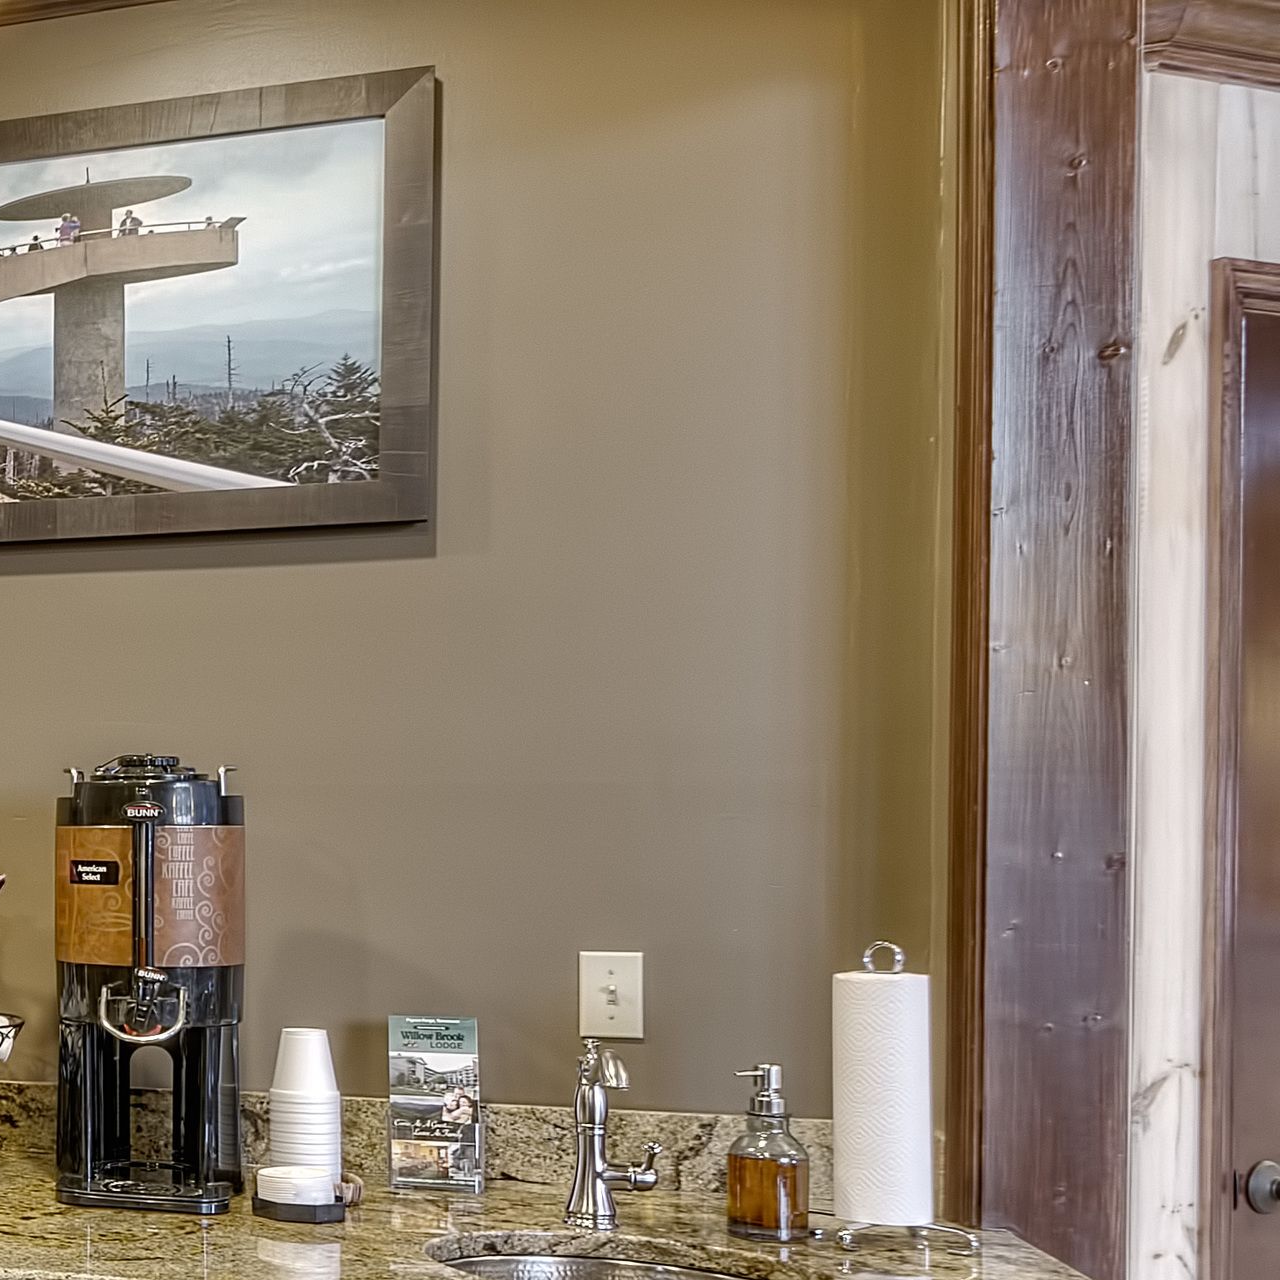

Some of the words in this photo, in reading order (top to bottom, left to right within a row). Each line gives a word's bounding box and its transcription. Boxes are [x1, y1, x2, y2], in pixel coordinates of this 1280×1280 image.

[127, 808, 159, 817] BUNN
[77, 864, 107, 872] American
[81, 873, 101, 881] Select
[401, 1031, 433, 1041] Willow
[435, 1031, 464, 1041] Brook
[430, 1041, 463, 1049] LODGE
